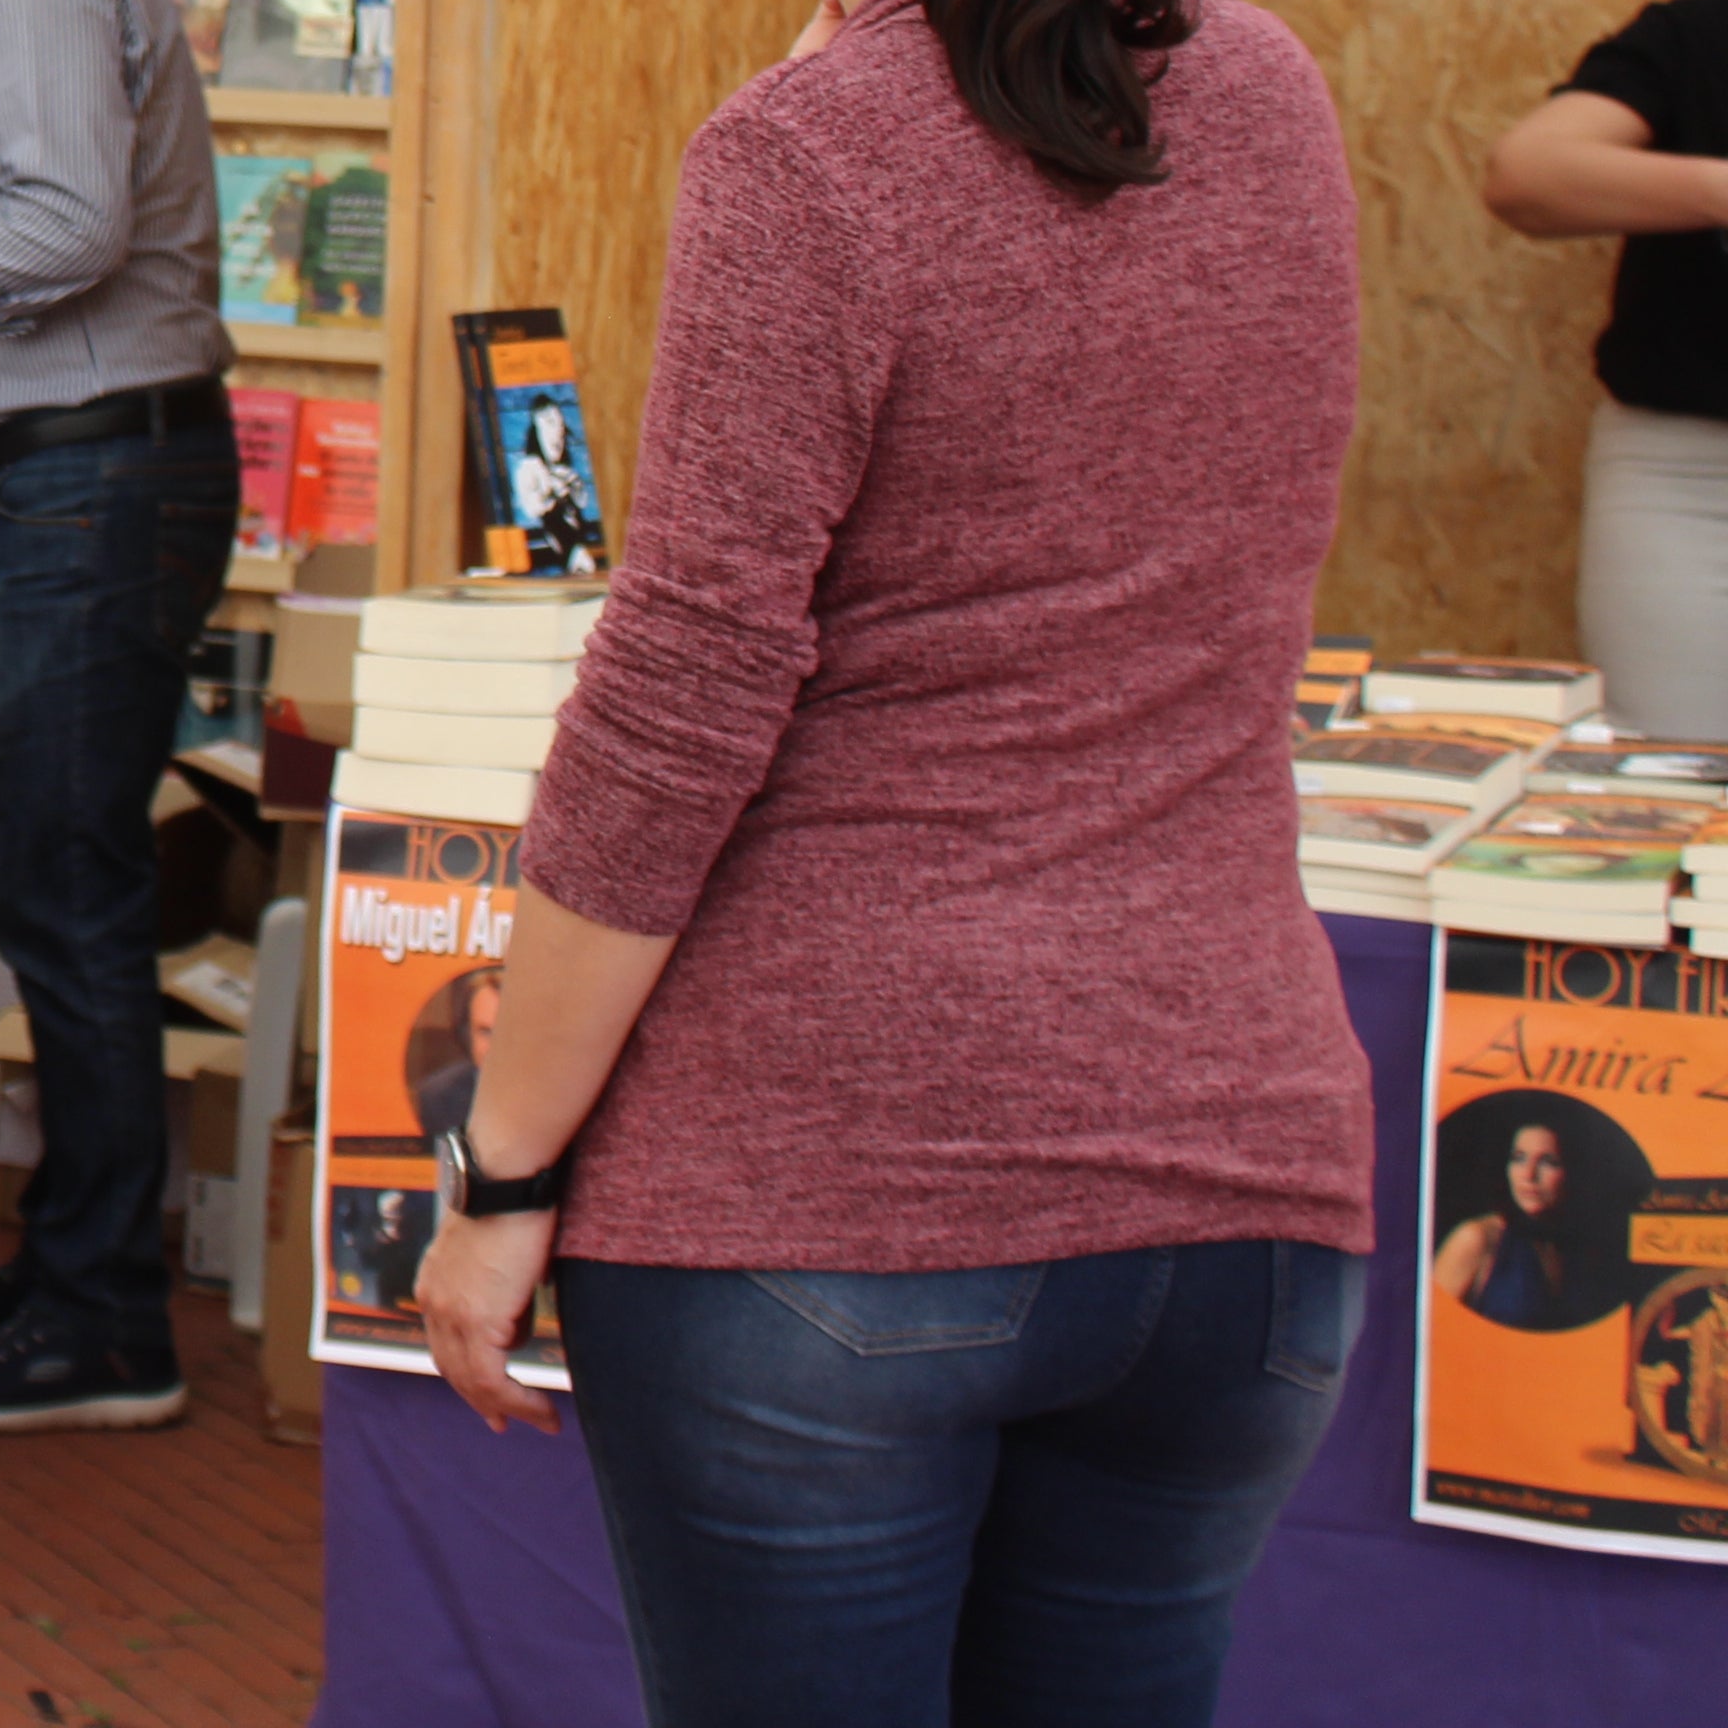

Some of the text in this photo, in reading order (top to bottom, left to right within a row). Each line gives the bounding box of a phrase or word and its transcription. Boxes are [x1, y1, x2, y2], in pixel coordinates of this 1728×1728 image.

[407, 825, 520, 887] HOY
[341, 885, 461, 962] Miguel
[1525, 940, 1656, 1009] HOY
[1451, 1013, 1688, 1095] Amira
